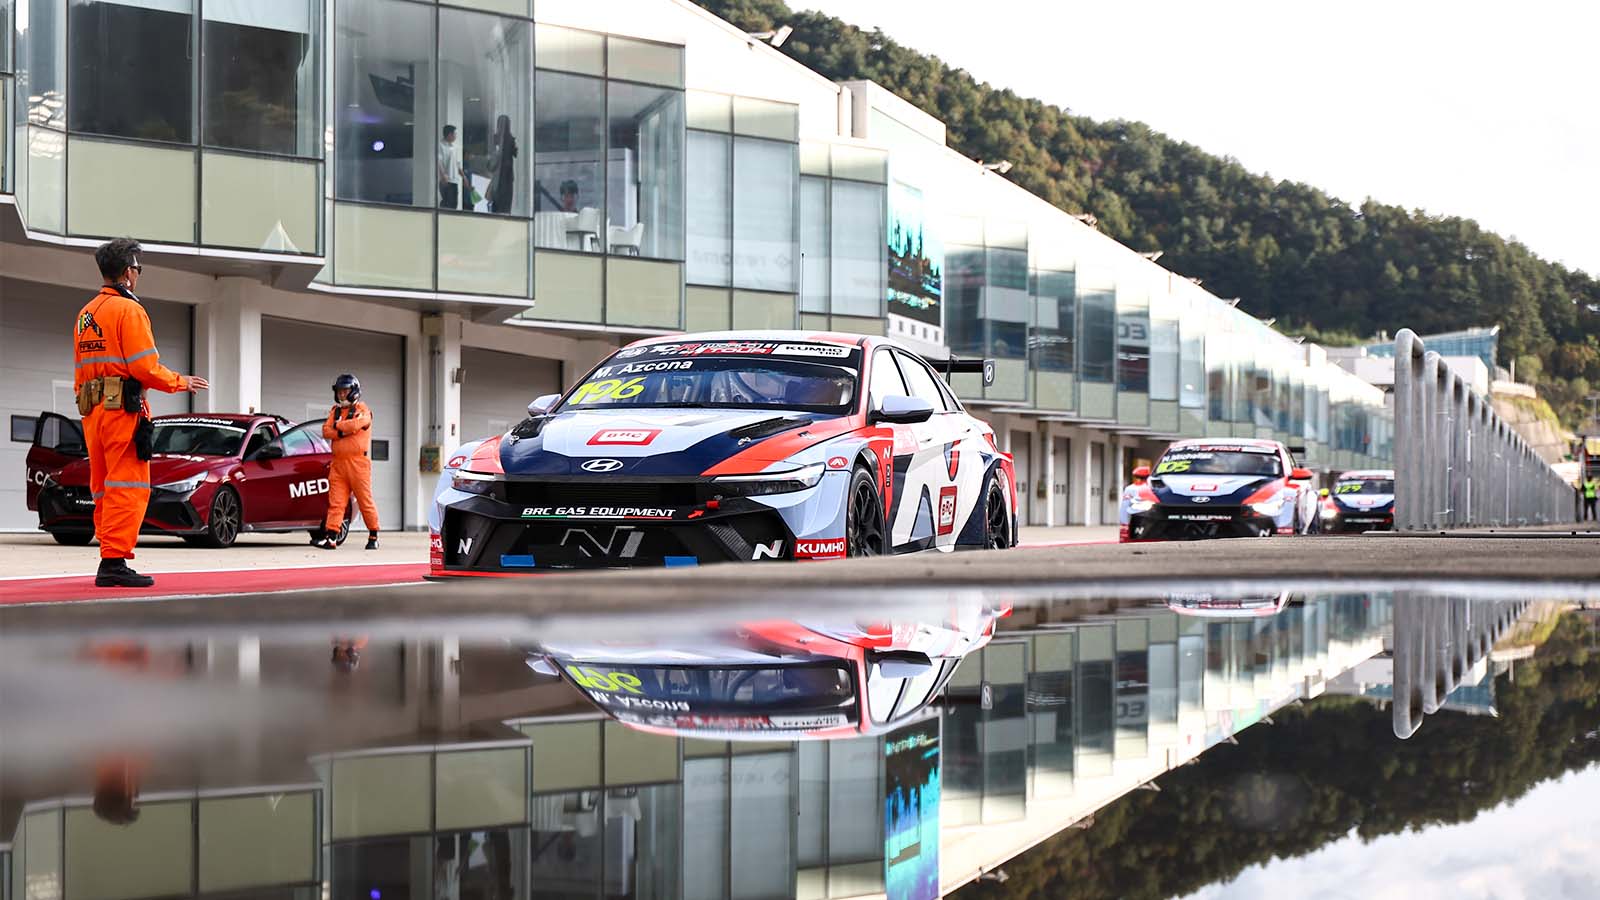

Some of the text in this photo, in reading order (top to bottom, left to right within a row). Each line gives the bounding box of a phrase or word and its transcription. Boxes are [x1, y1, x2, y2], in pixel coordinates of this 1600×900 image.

[785, 345, 843, 353] KUMHO
[592, 360, 694, 380] M. Azcona
[568, 376, 648, 405] 196
[522, 507, 677, 517] BRC GAS EQUIPMENT
[796, 541, 845, 554] KUMHO
